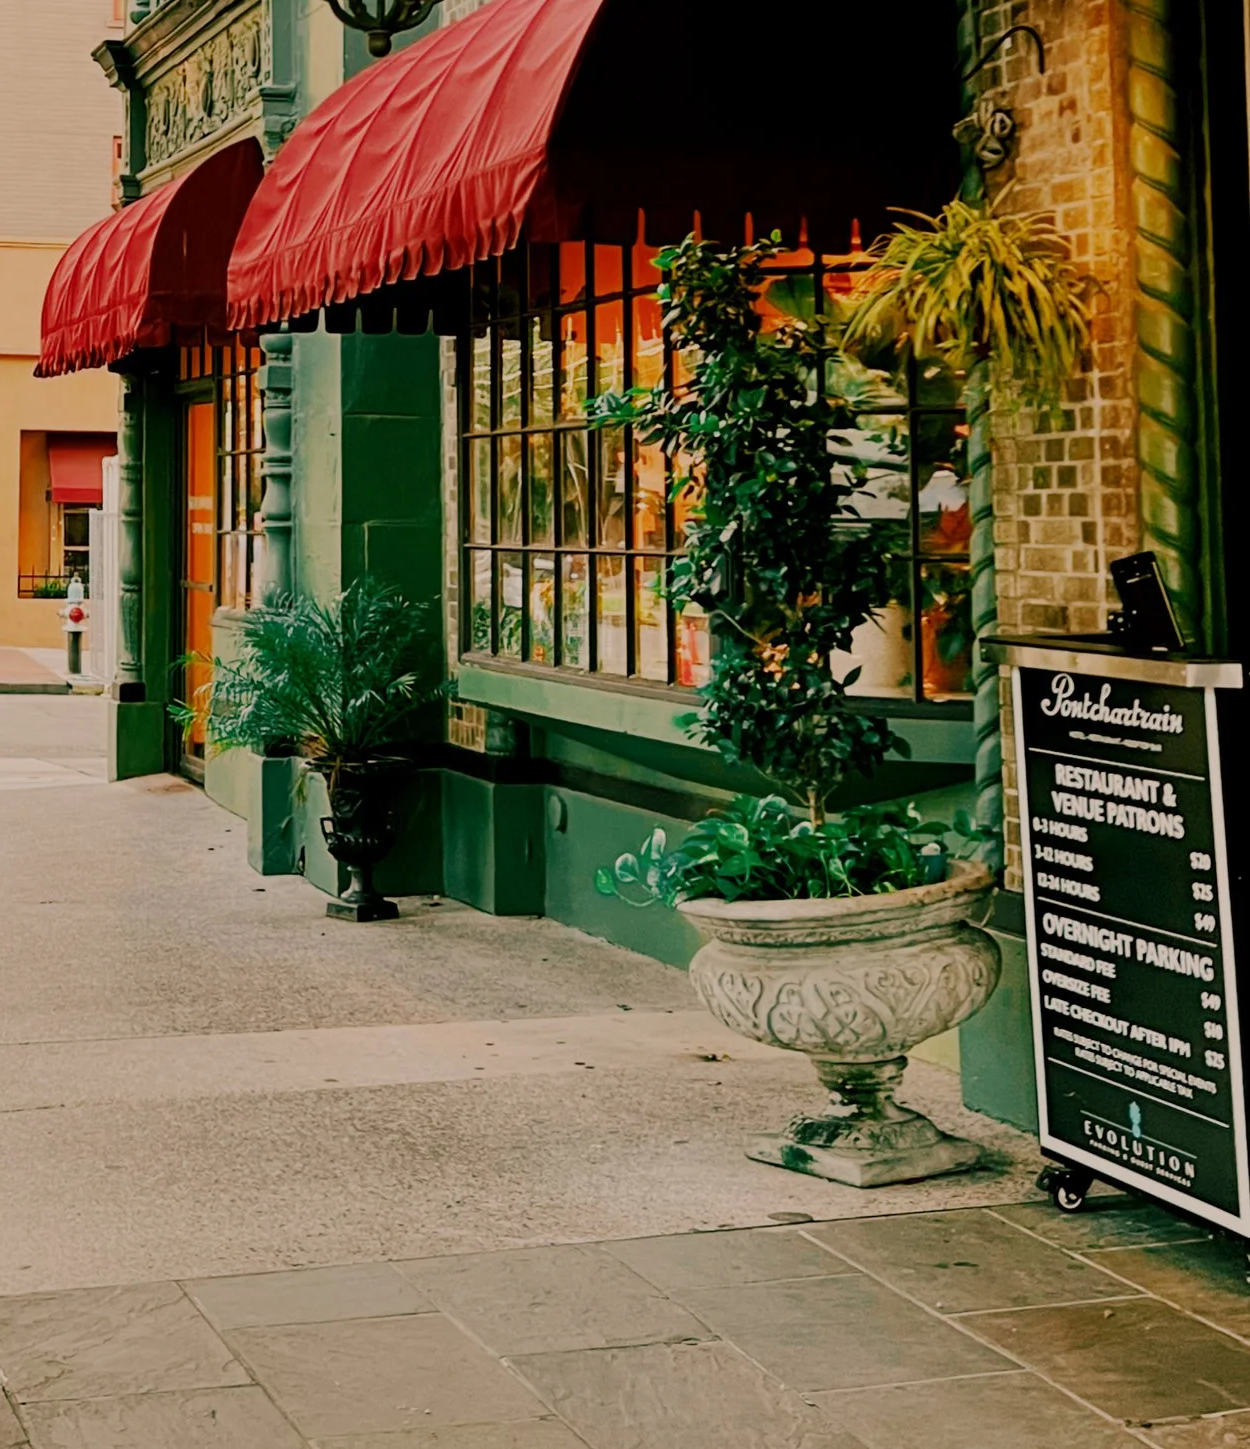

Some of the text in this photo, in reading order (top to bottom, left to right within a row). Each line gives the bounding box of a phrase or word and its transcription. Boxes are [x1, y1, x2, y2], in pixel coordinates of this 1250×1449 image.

[1040, 673, 1184, 734] Pontchartrain
[1054, 763, 1177, 808] RESTAURANT &
[1048, 819, 1089, 843] HOURS
[1051, 790, 1185, 840] VENUE PATRONS
[1053, 848, 1094, 872] HOURS
[1191, 881, 1214, 902] $25
[1060, 877, 1101, 903] HOURS
[1040, 942, 1096, 972] STANDARD
[1095, 959, 1117, 979] FEE
[1042, 912, 1215, 982] OVERNIGHT PARKING
[1042, 968, 1091, 998] OVERSIZE
[1090, 984, 1112, 1004] FEE
[1043, 994, 1070, 1016] LATE
[1070, 1004, 1130, 1036] CHECKOUT
[1129, 1024, 1168, 1050] AFTER
[1204, 1049, 1226, 1070] $25
[1083, 1120, 1195, 1179] EVOLUTION
